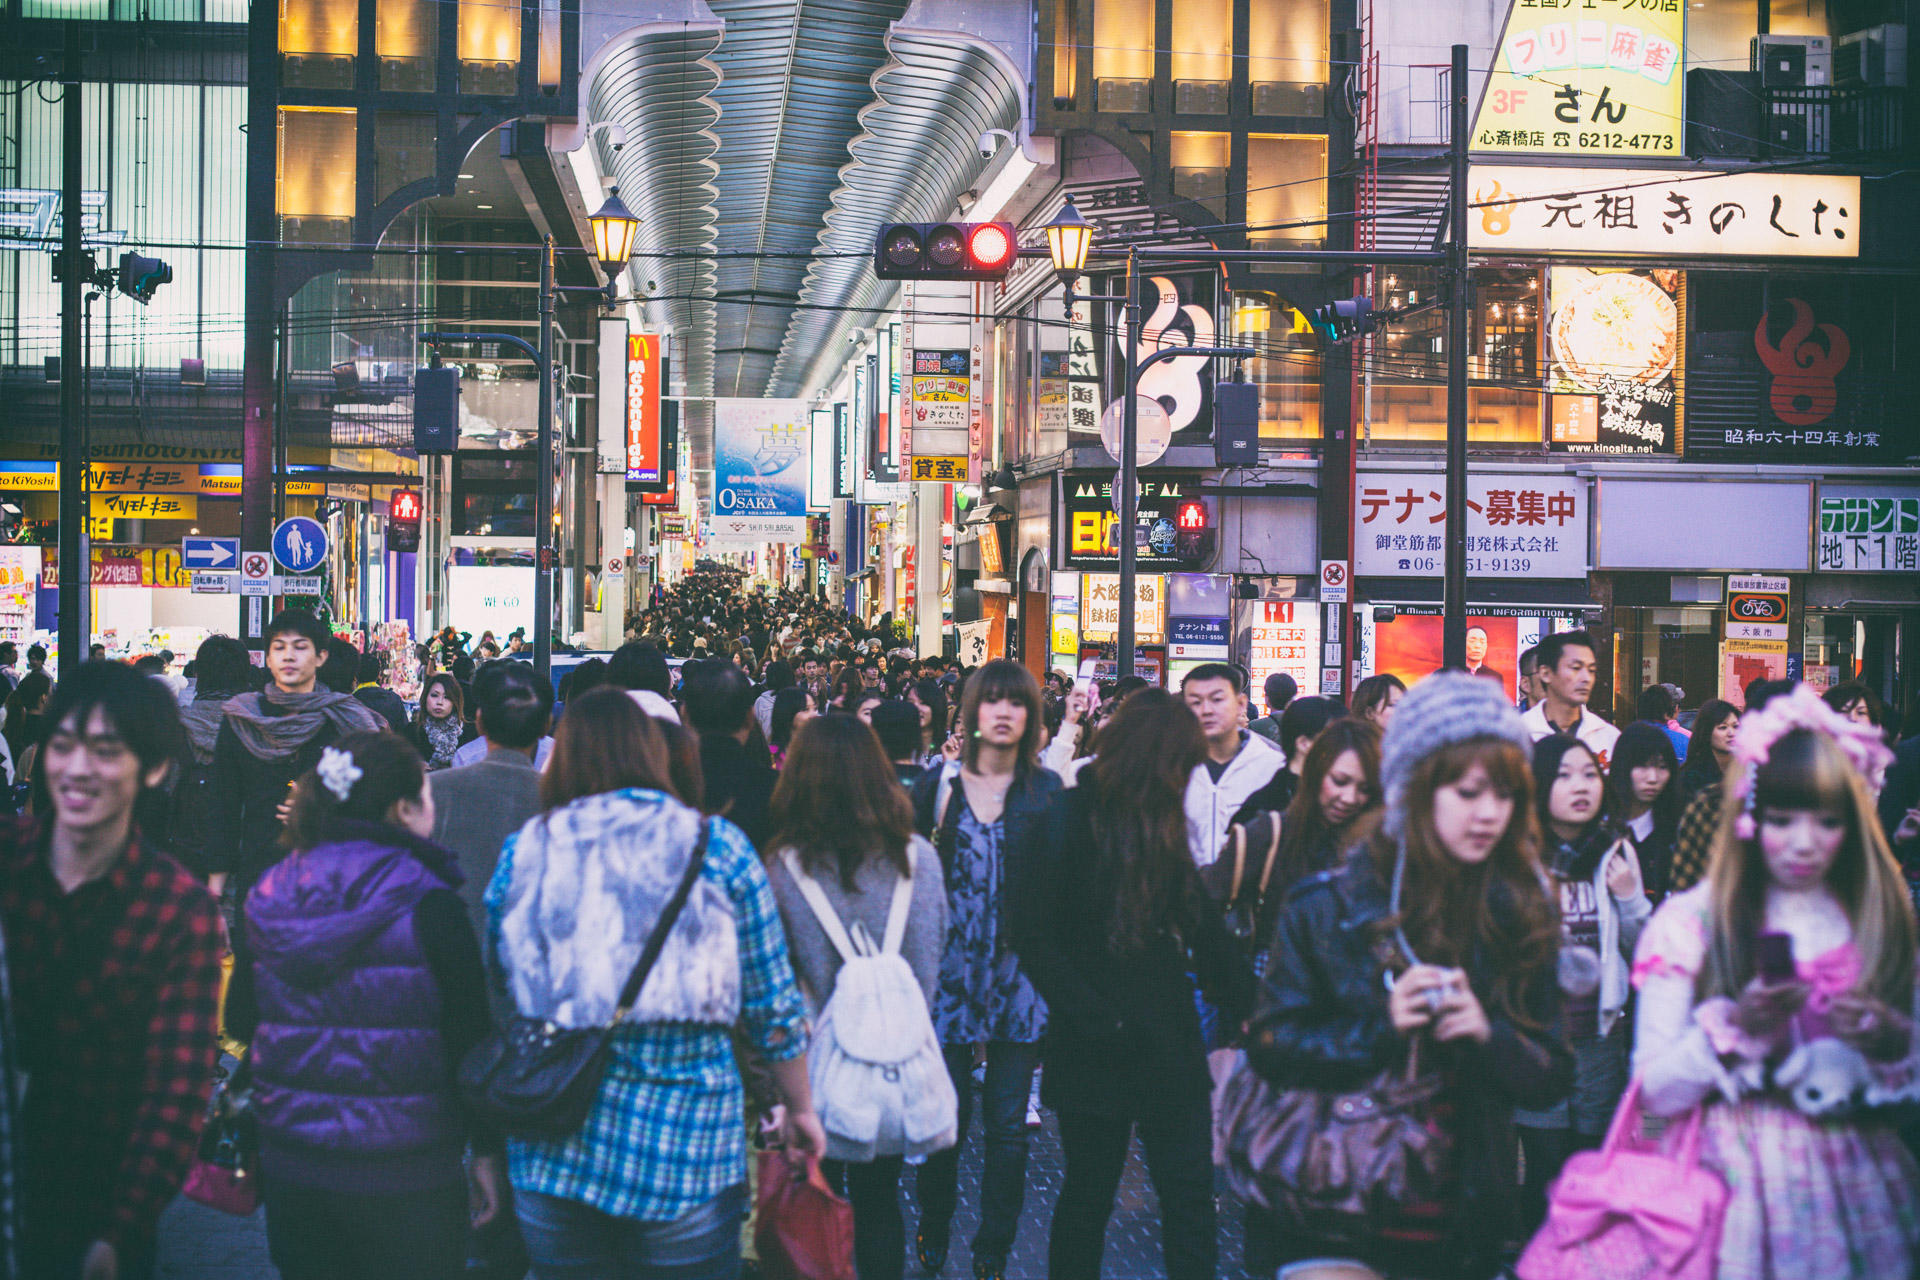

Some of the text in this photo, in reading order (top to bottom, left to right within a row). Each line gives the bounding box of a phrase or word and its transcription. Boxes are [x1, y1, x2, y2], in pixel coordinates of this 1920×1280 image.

[1514, 28, 1671, 72] フリー麻雀
[1492, 89, 1528, 114] 3F
[1554, 84, 1627, 124] さん
[1479, 130, 1674, 150] 心斎橋店 6212-4773
[1541, 191, 1848, 238] 元祖 きのした
[1725, 429, 1880, 447] 昭和六十四年創業
[1567, 444, 1653, 454] www.kinosita.net
[11, 476, 55, 487] KiYoshi
[105, 494, 182, 516] マツモトキヨシ
[719, 488, 776, 509] OSAKA
[1821, 499, 1918, 532] テナント
[1375, 534, 1559, 553] 御堂筋都開発株式会社
[1821, 535, 1919, 569] 地下1階
[1414, 558, 1531, 572] 06-51-9139
[1092, 584, 1155, 603] 大阪物
[1493, 608, 1565, 618] INFORMATION
[1742, 627, 1772, 637] 大阪市
